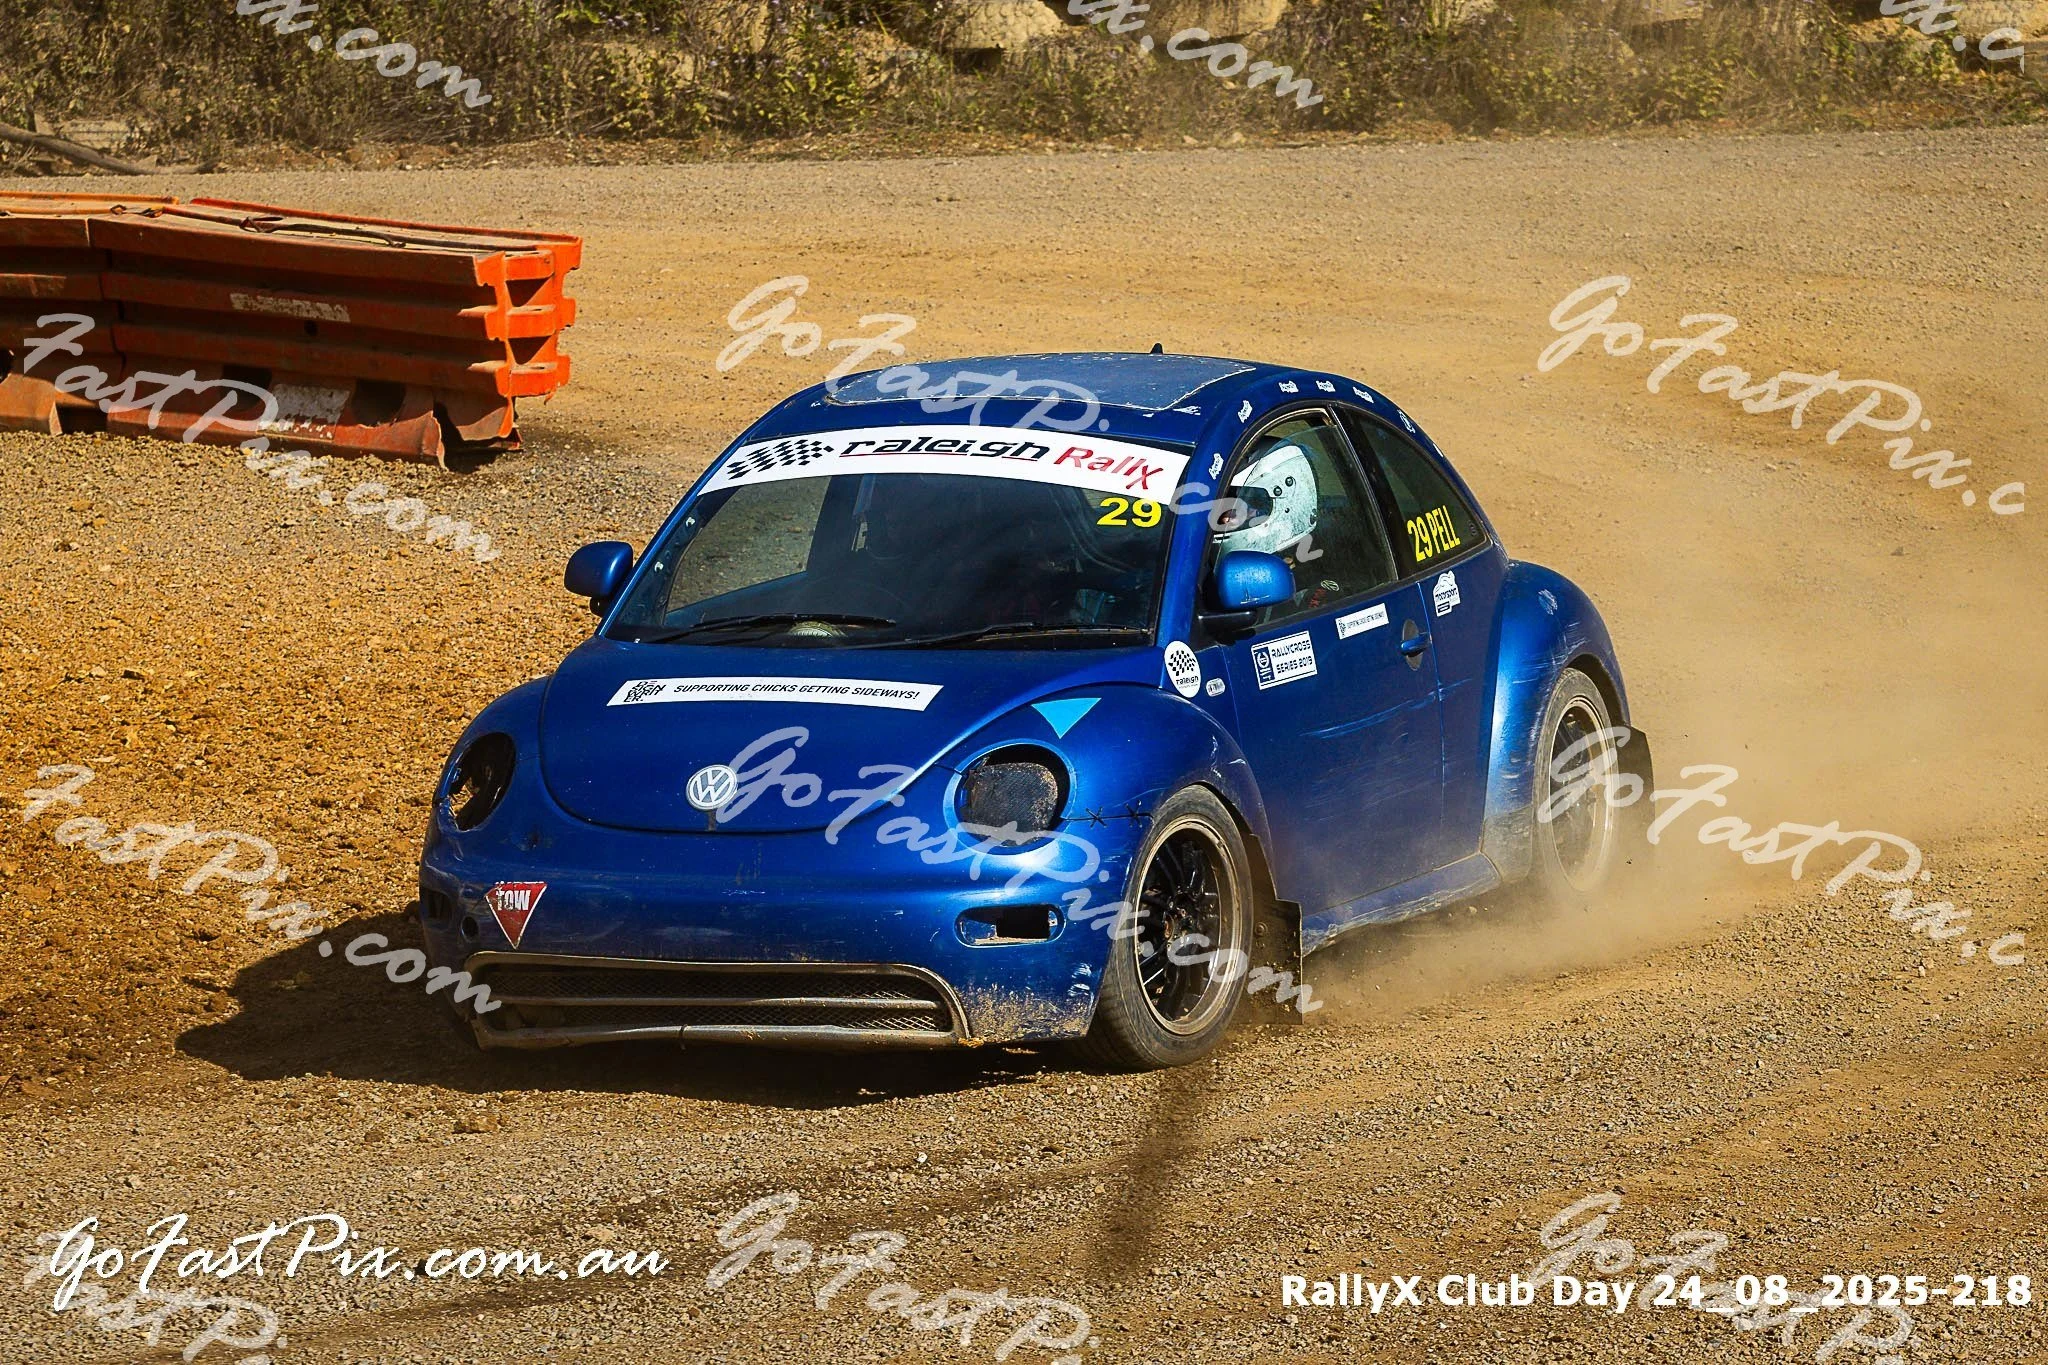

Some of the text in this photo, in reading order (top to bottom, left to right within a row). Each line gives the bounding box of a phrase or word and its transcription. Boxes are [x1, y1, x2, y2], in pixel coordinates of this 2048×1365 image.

[839, 436, 1050, 462] raleigh
[1097, 497, 1162, 528] 29
[1406, 505, 1461, 562] 29 PELL
[673, 684, 920, 700] SUPPORTING CHICKS GETTING SIDEWAYS!
[496, 889, 531, 911] TOW
